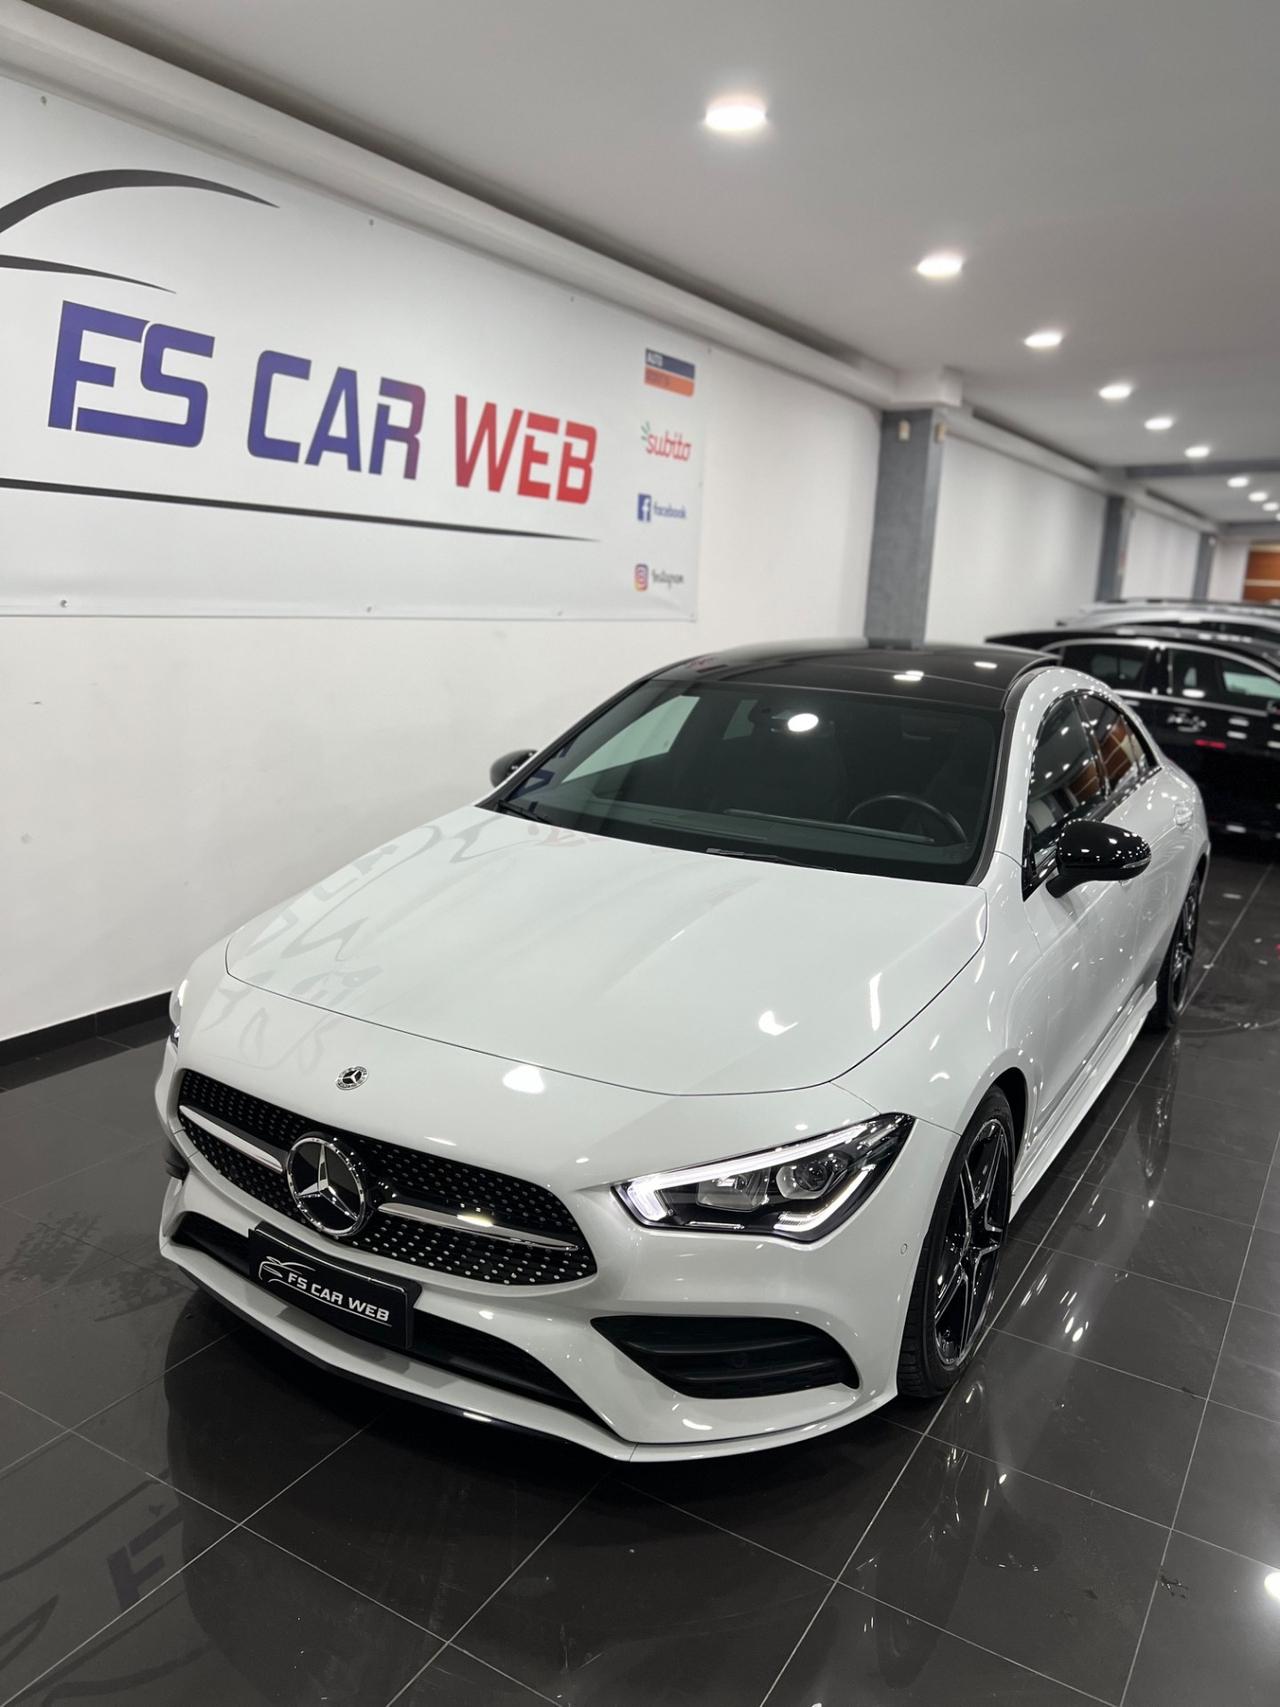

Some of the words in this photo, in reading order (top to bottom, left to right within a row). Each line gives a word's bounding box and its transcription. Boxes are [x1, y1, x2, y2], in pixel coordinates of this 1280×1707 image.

[47, 299, 215, 448] FS
[247, 349, 427, 481] CAR
[454, 393, 598, 505] WEB
[646, 429, 692, 462] subito
[653, 501, 687, 519] facebook
[287, 1272, 308, 1290] FS
[310, 1283, 344, 1305] CAR
[348, 1297, 390, 1322] WEB
